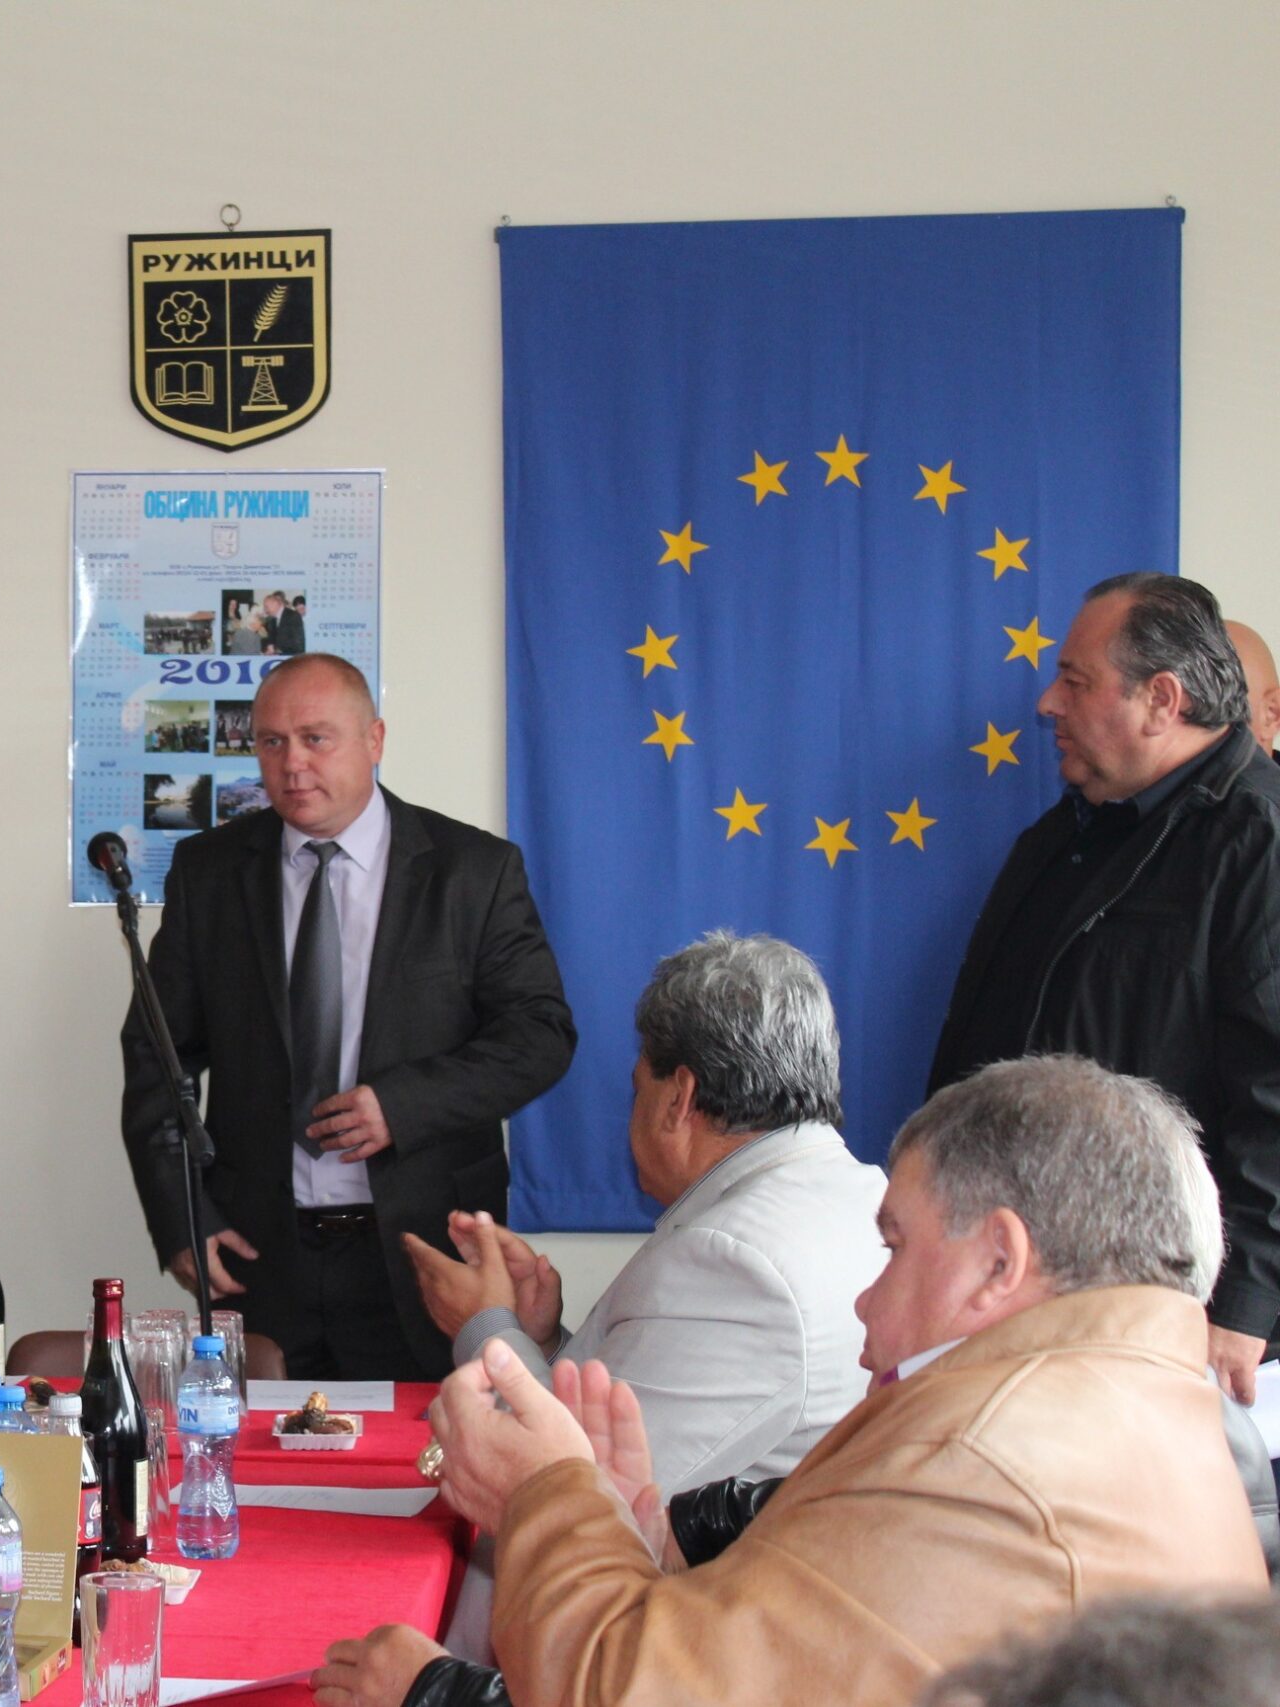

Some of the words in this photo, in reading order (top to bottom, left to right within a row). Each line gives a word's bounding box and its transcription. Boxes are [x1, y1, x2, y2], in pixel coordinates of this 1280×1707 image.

[142, 249, 316, 273] РУЖИНЦИ
[144, 490, 218, 522] ОБЩИНА
[224, 489, 310, 522] РУЖИНЦИ
